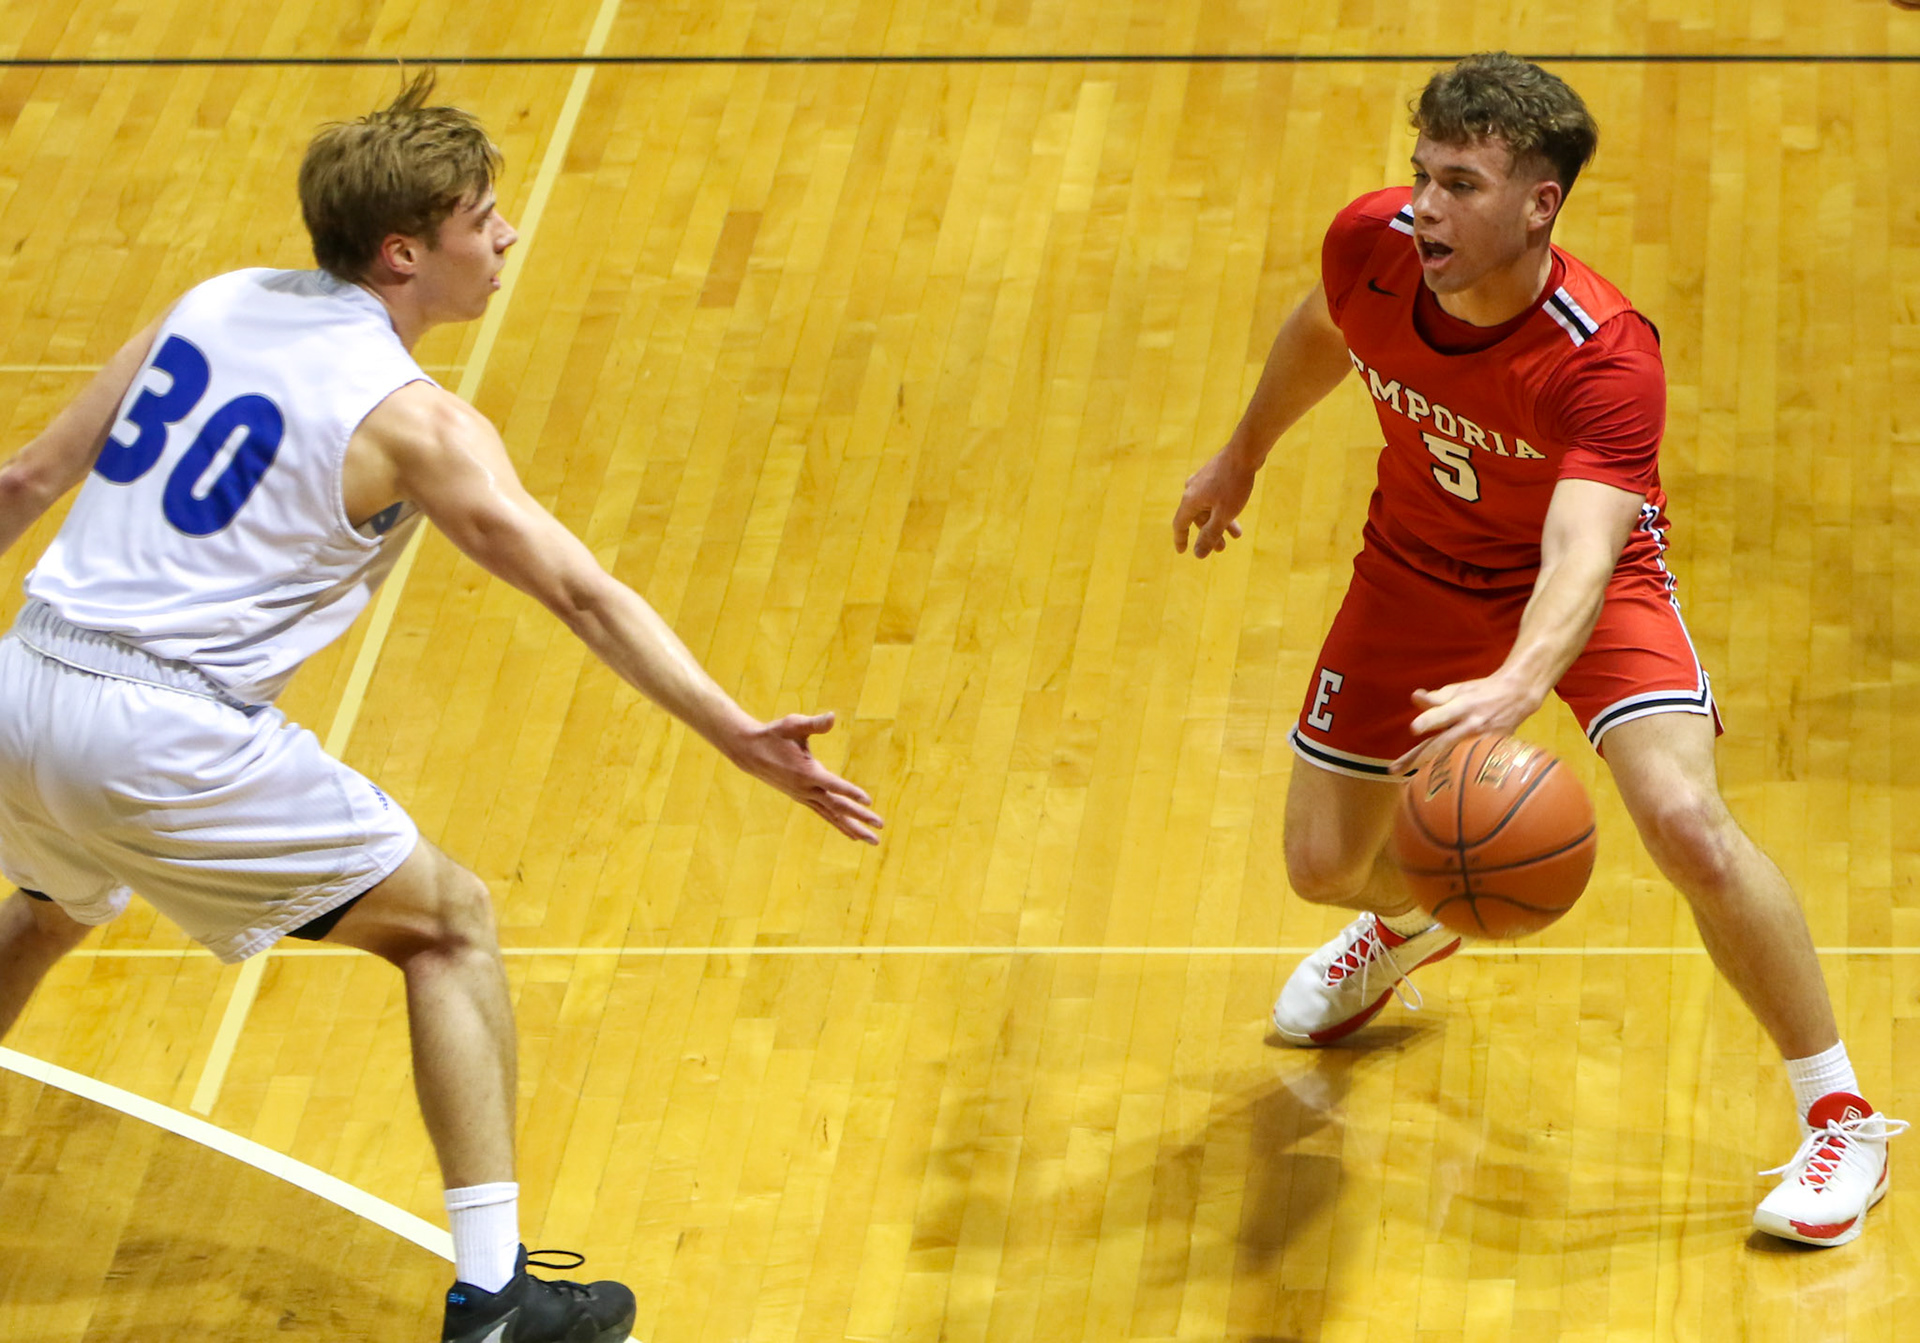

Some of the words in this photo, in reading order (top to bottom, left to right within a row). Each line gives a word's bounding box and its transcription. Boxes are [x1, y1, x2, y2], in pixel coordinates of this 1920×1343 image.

[92, 333, 285, 539] 30
[1419, 430, 1481, 504] 5
[1307, 666, 1345, 733] E
